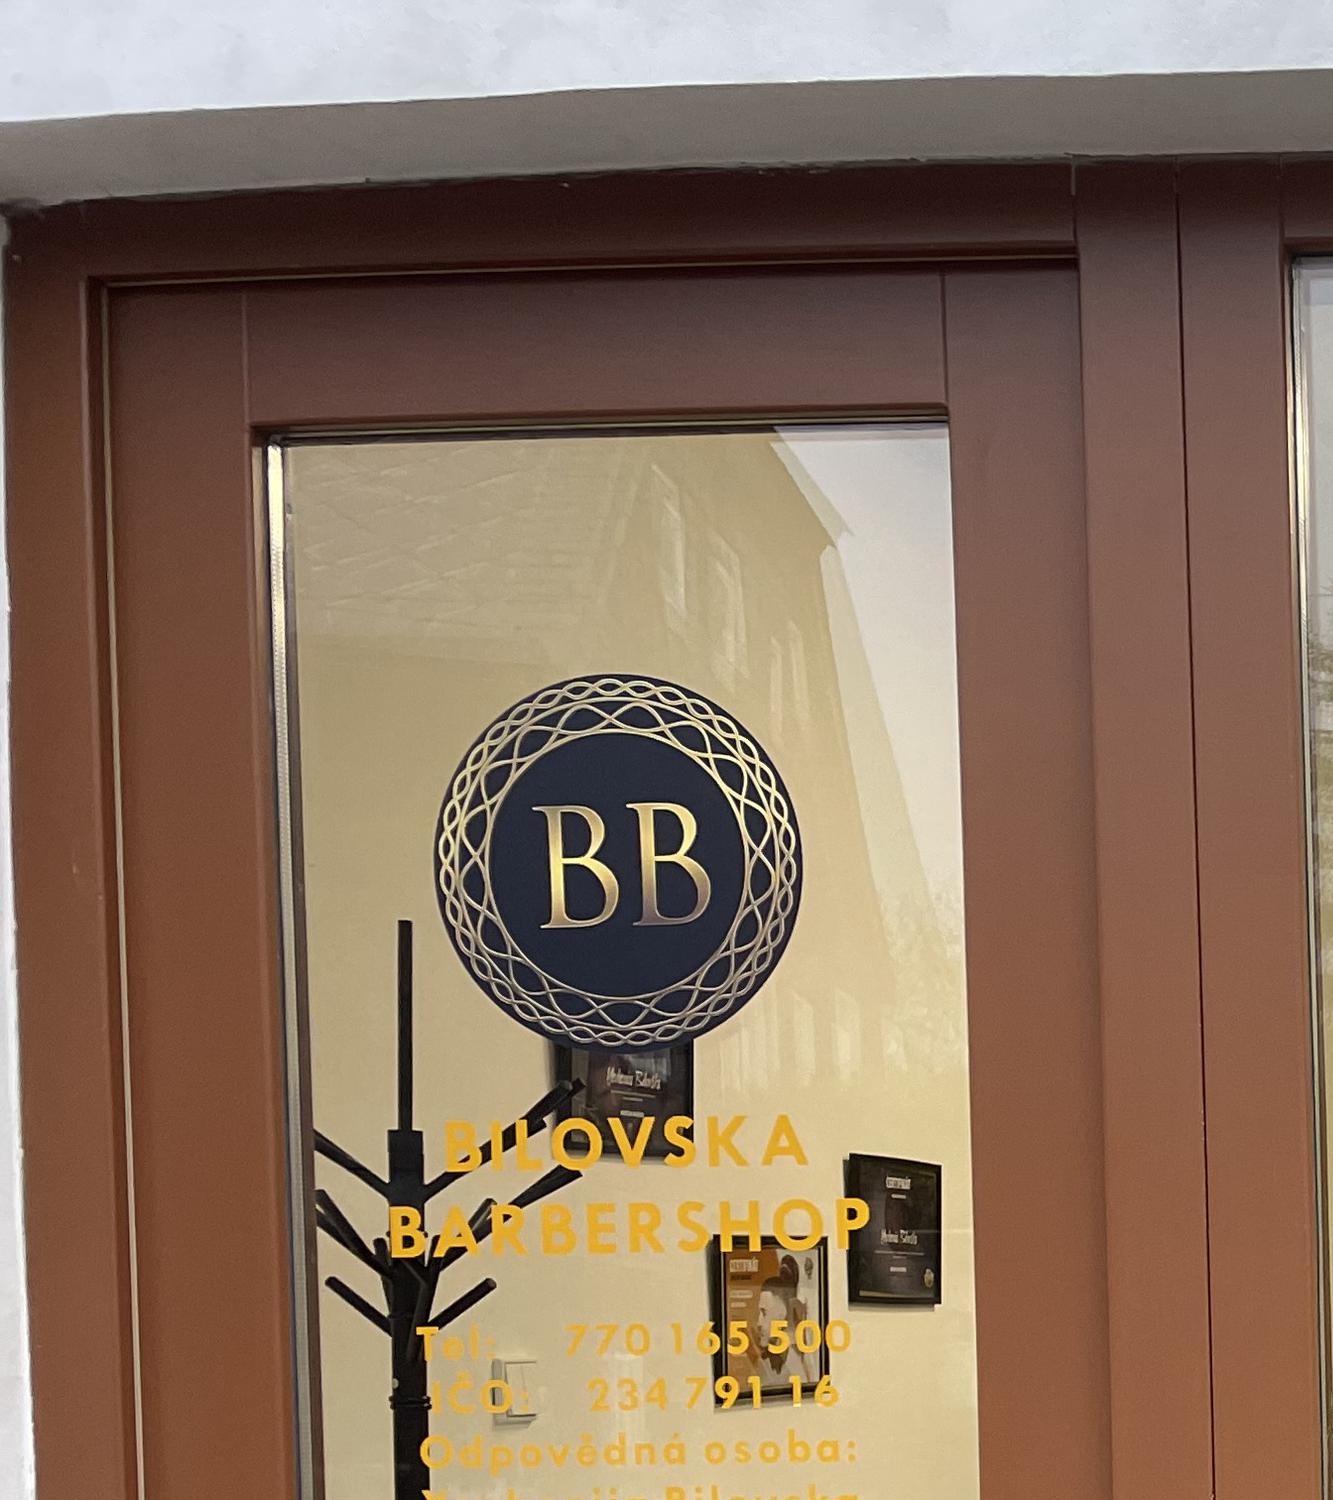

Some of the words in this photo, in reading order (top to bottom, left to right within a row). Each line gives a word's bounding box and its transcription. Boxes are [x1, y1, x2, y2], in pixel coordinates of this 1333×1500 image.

[531, 802, 712, 929] BB
[444, 1114, 809, 1172] BILOVSKA
[389, 1198, 871, 1259] BARBERSHOP
[415, 1324, 497, 1361] Tel:
[564, 1323, 651, 1357] 770
[670, 1320, 750, 1355] 165
[767, 1319, 852, 1354] 500
[431, 1369, 529, 1415] IČO:
[586, 1376, 668, 1413] 234
[686, 1375, 761, 1410] 791
[792, 1375, 839, 1409] 16
[419, 1433, 687, 1478] Odpovědná
[704, 1428, 858, 1465] osoba:
